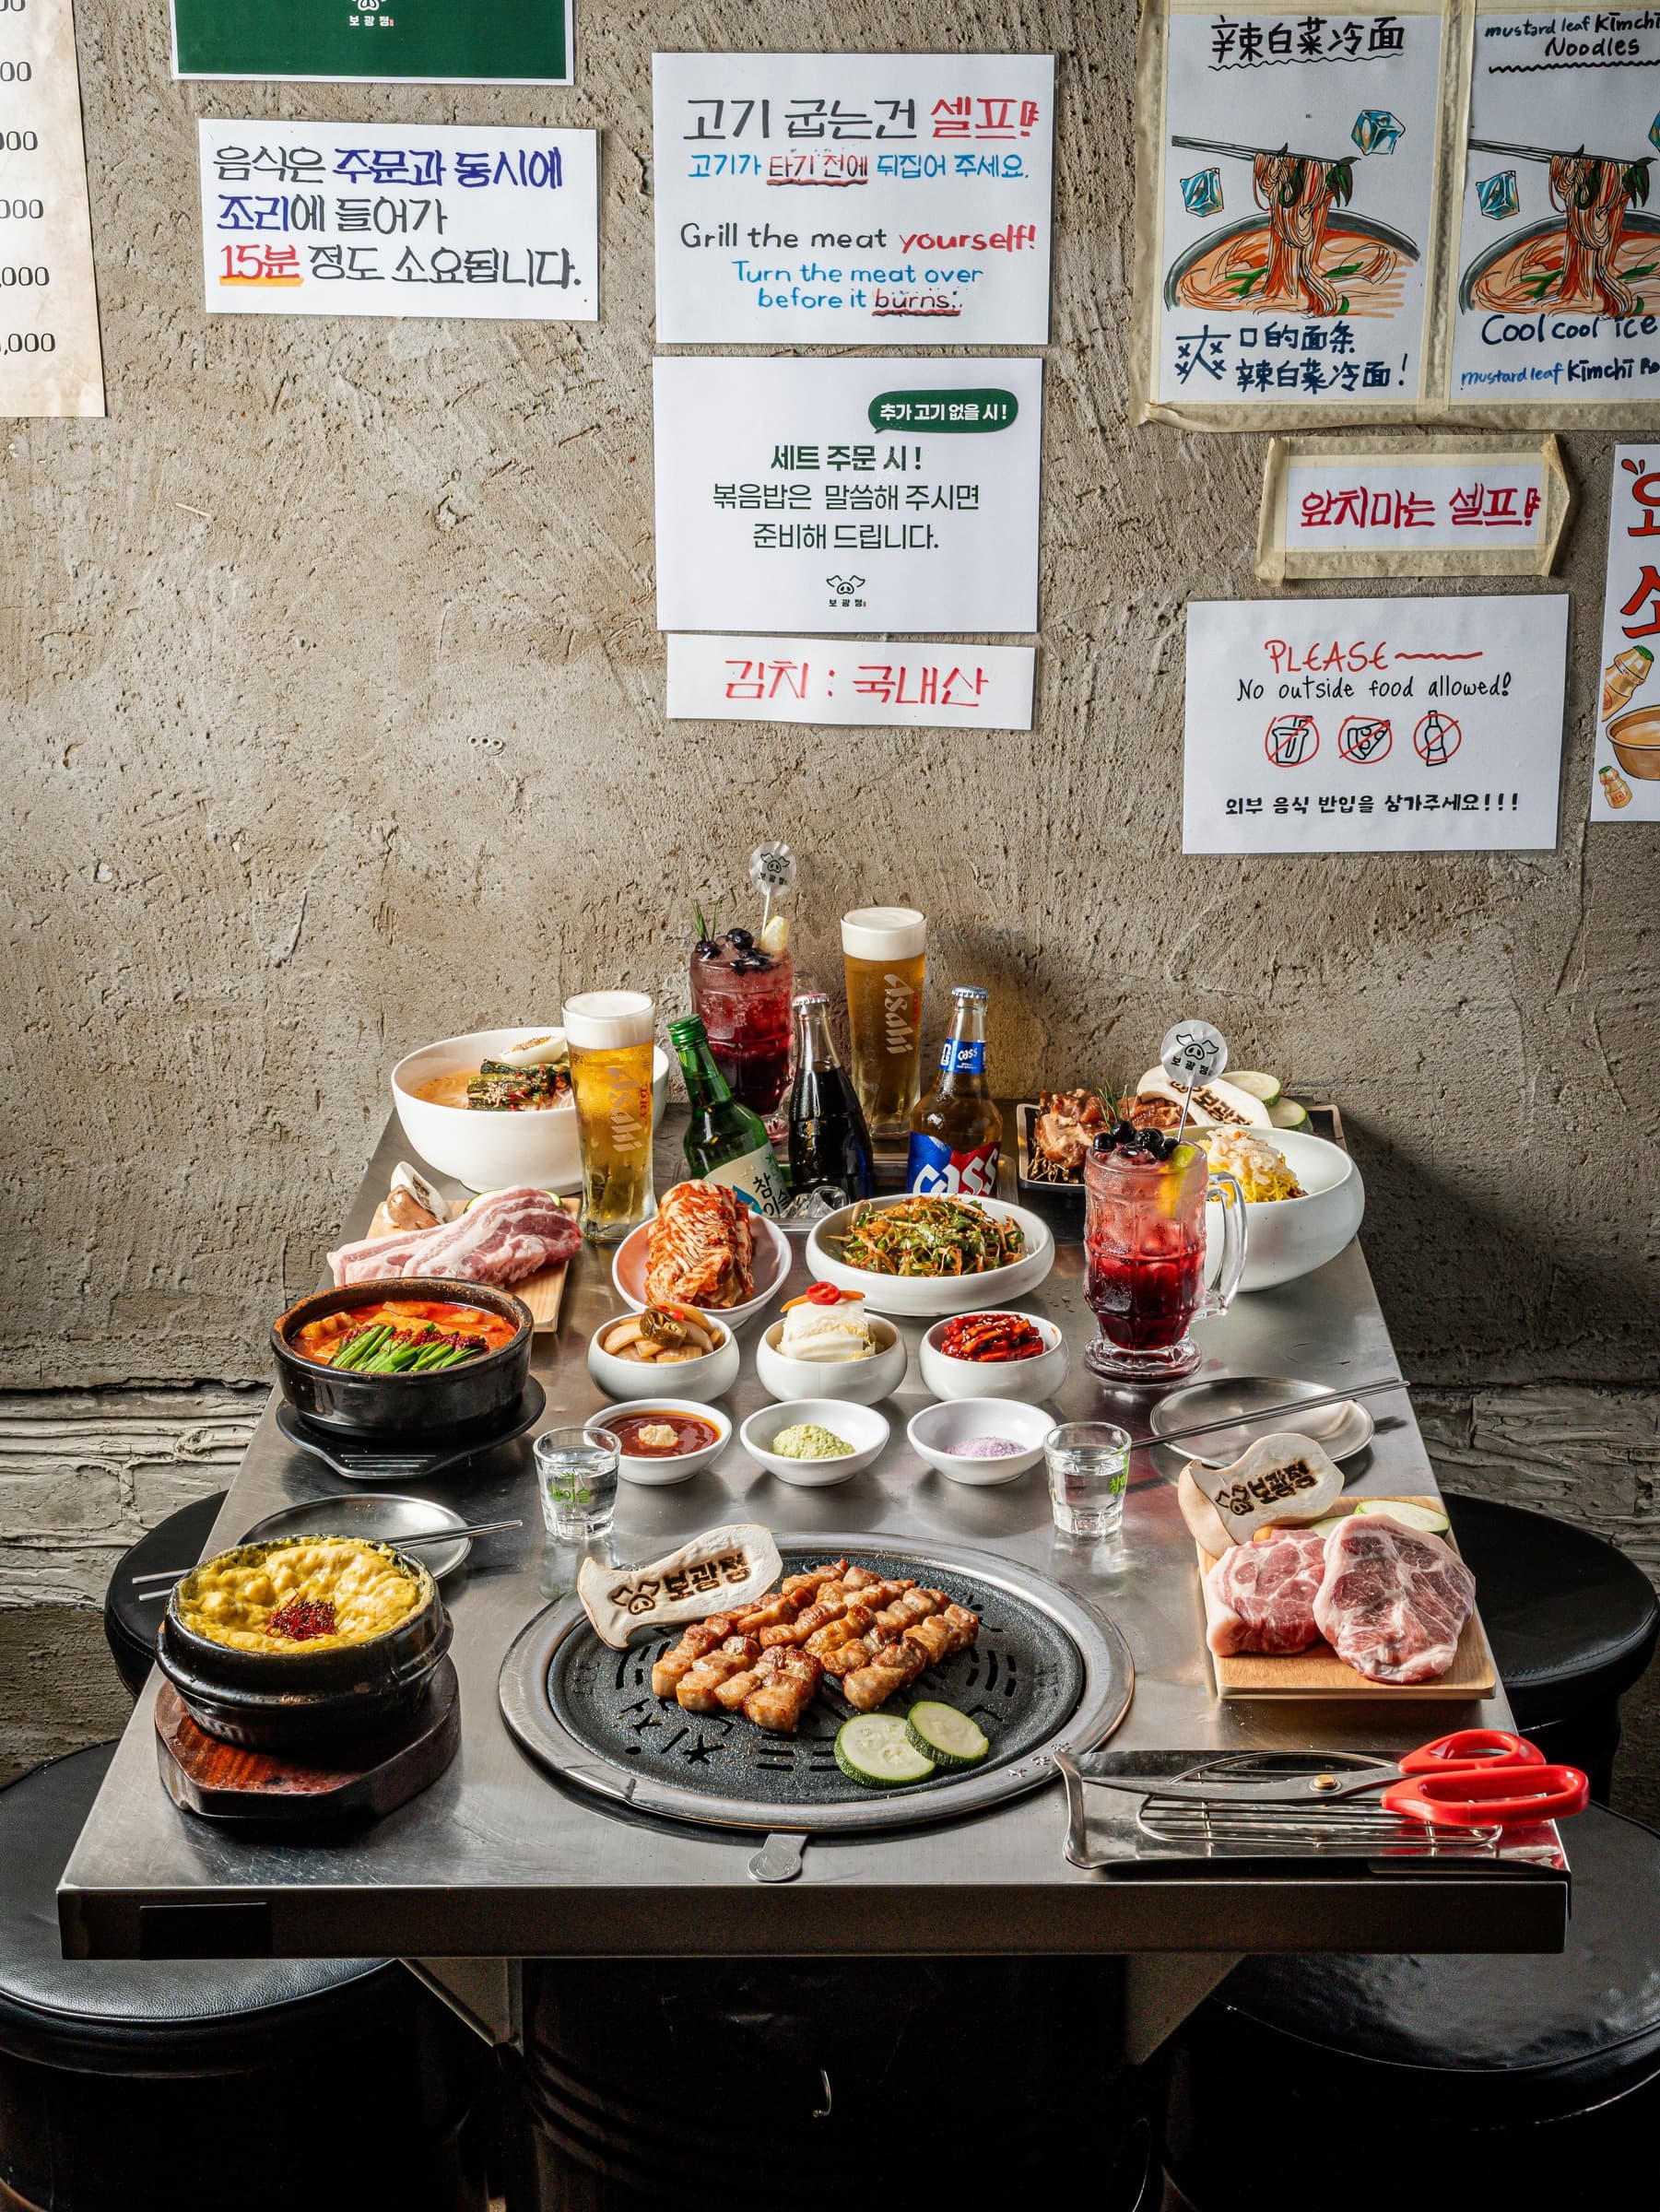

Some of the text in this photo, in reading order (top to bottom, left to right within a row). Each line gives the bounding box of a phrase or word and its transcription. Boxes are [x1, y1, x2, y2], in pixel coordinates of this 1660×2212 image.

[1210, 14, 1406, 64] 辣白菜冷面
[1484, 18, 1557, 40] mustard
[1560, 15, 1591, 33] leaf
[1544, 36, 1641, 57] Noodles
[682, 99, 771, 141] 고기
[783, 98, 918, 140] 굽는건
[212, 145, 563, 190] 음식은 주문과 동시에
[687, 153, 1030, 180] 고기가 타기 전에 뒤집어 주세요.
[216, 193, 449, 236] 조리에 들어가
[680, 221, 1037, 254] Grill the meat yourself!
[219, 241, 583, 290] 15분 정도 소요됩니다.
[731, 259, 984, 284] Turn the meat over
[757, 286, 843, 310] before
[850, 288, 867, 309] it
[1480, 313, 1658, 347] Cool cool ice
[1461, 366, 1528, 386] mustard
[1529, 361, 1565, 386] leaf
[880, 404, 912, 421] 추가
[914, 404, 945, 421] 고기
[948, 404, 980, 421] 없을
[770, 444, 821, 472] 세트
[826, 444, 877, 472] 주문
[712, 483, 980, 512] 볶음밥은 말씀해 주시면
[1300, 485, 1436, 530] 앞치마는
[752, 523, 939, 550] 준비해 드립니다.
[1264, 639, 1389, 675] PLEASE
[724, 660, 809, 700] 김치
[852, 665, 989, 708] 국내산
[1236, 671, 1513, 702] No outside food allowed!
[1225, 796, 1264, 816] 외부
[1272, 795, 1310, 816] 음식
[1317, 794, 1375, 814] 반입을
[884, 973, 914, 1053] Asahi
[607, 1066, 643, 1153] Asahi
